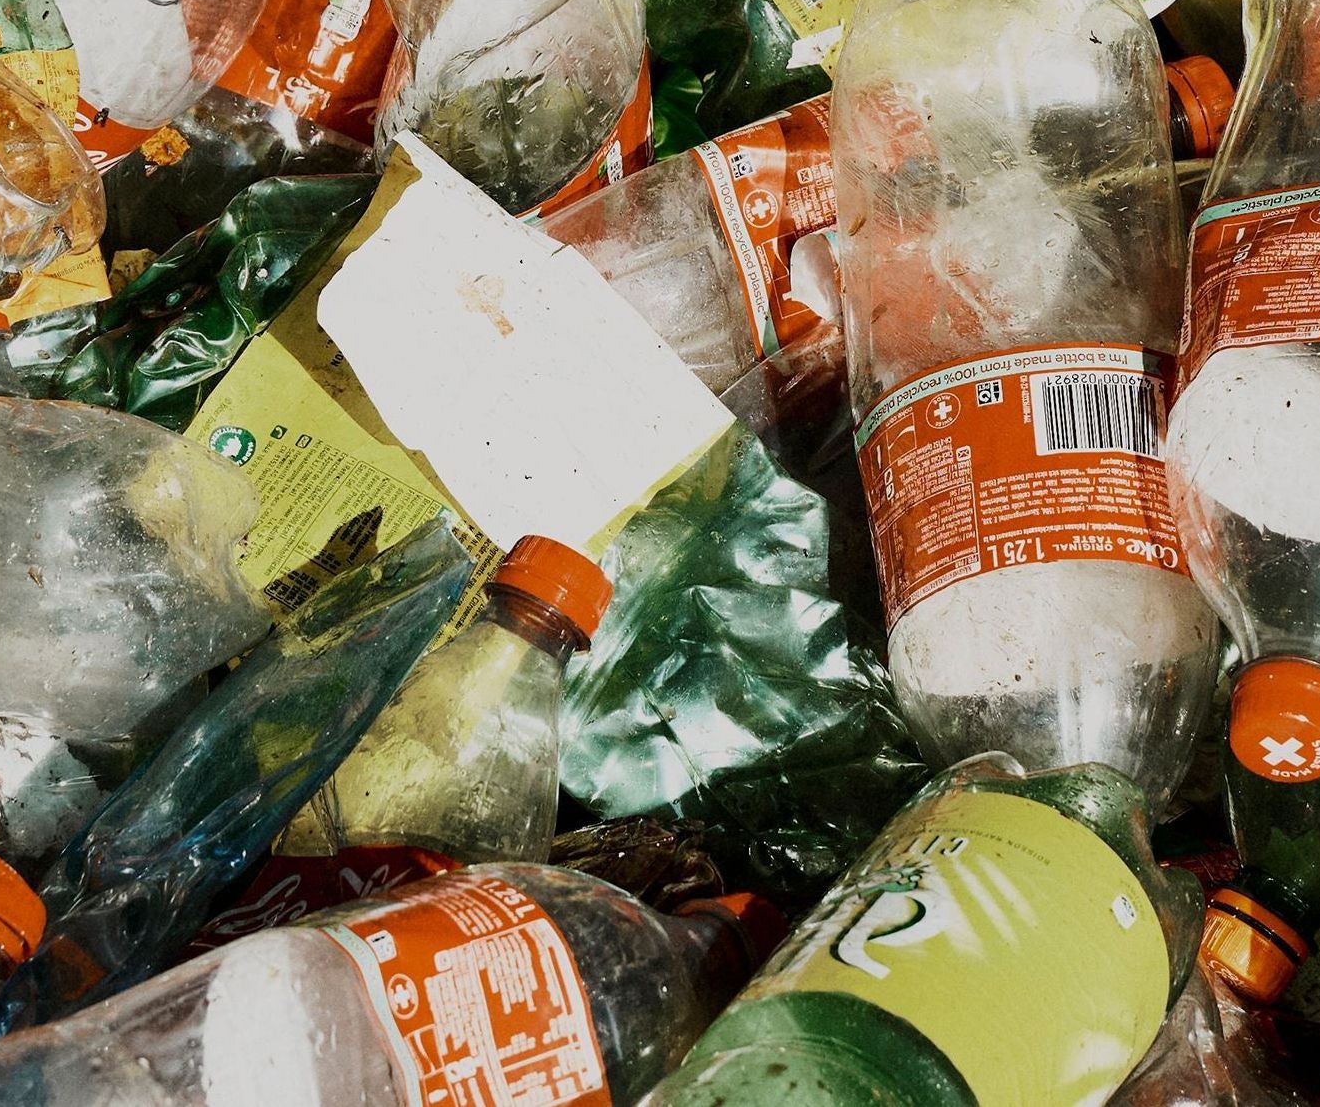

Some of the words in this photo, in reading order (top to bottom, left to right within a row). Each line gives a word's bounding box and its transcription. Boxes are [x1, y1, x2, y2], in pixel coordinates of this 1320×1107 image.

[707, 149, 727, 181] from
[717, 181, 738, 217] 100%
[1261, 204, 1301, 218] coke.com
[726, 216, 754, 272] recycled
[754, 244, 773, 284] coke.com
[1013, 351, 1052, 371] made
[1054, 350, 1095, 364] bottle
[1097, 352, 1106, 362] a
[1108, 351, 1128, 367] I'm
[942, 366, 977, 384] 100%
[980, 359, 1012, 375] from
[1045, 372, 1097, 386] 028921
[895, 374, 943, 409] recycled
[1052, 538, 1112, 556] ORIGINAL
[1071, 532, 1111, 544] TASTE
[986, 545, 998, 565] L
[1002, 536, 1044, 563] 1.25
[1124, 534, 1178, 571] Coke
[1270, 764, 1313, 778] MADE
[481, 874, 525, 910] 1.25
[512, 899, 534, 920] L
